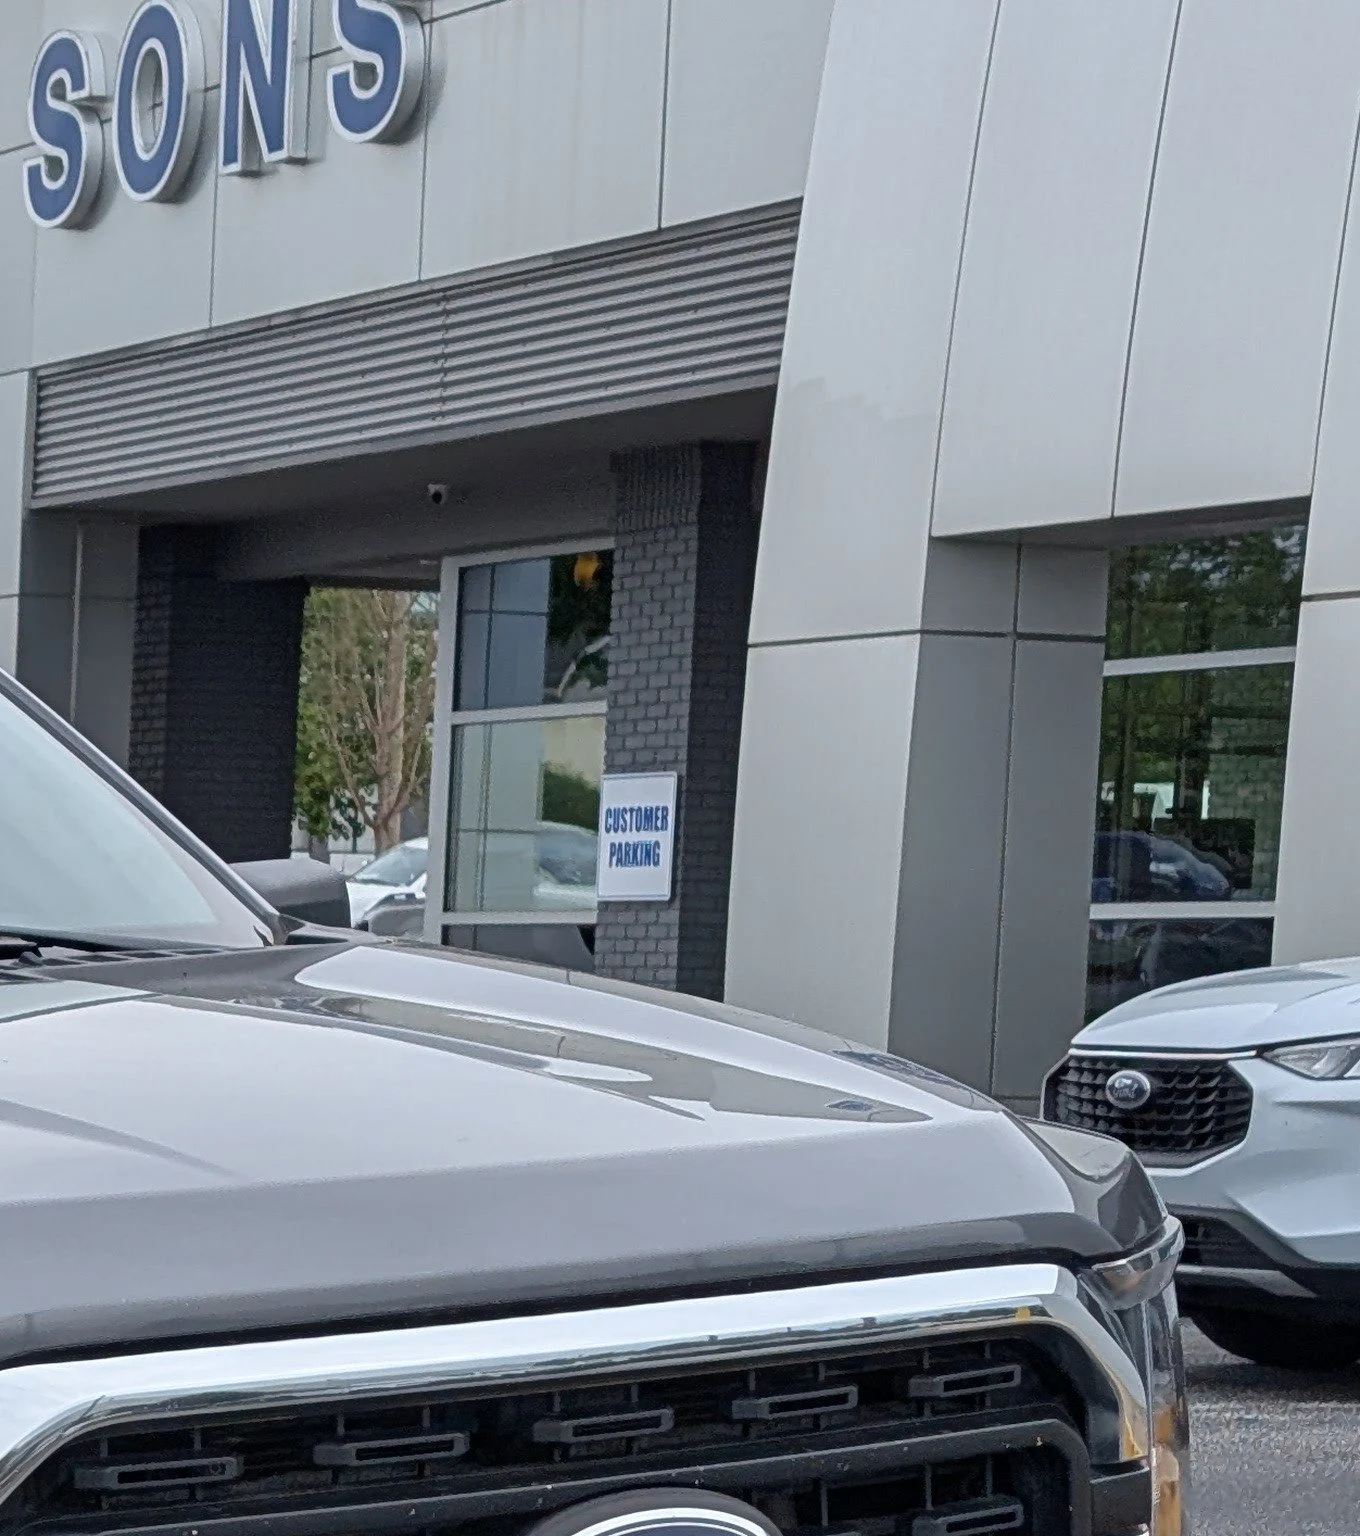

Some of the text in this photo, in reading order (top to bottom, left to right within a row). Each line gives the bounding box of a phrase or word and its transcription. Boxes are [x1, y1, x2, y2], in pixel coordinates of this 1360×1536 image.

[23, 0, 408, 228] SONS
[604, 805, 670, 834] CUSTOMER
[608, 840, 662, 869] PARKING
